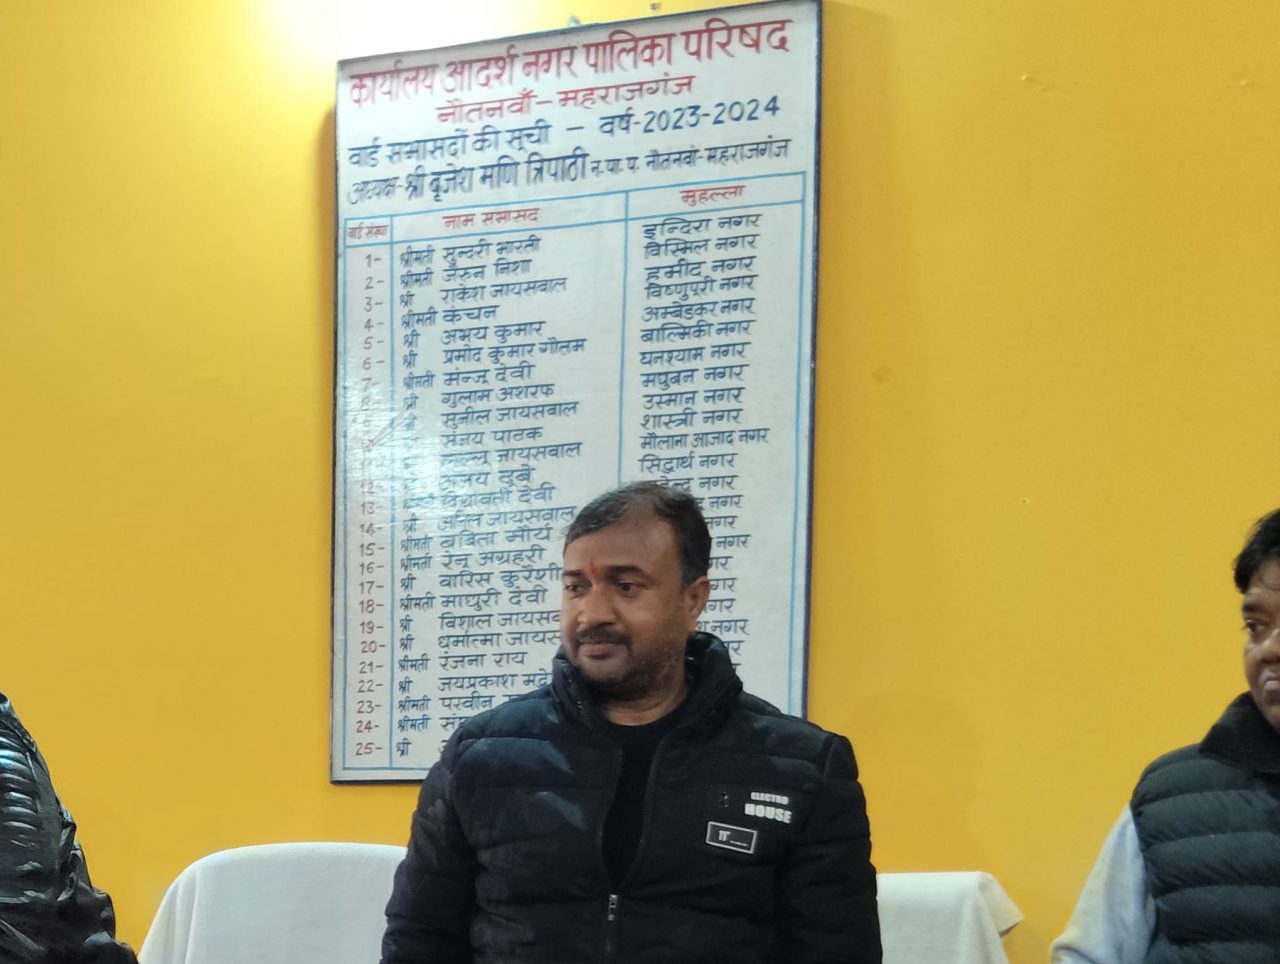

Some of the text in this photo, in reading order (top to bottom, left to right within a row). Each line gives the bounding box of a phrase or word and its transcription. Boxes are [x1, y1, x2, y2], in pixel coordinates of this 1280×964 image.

[350, 17, 794, 106] कार्यालय आदर्श नगर पालिका परिषद
[557, 72, 696, 109] महराजगंज
[348, 136, 382, 167] वार्ड
[386, 128, 469, 164] सभासदों
[472, 124, 502, 151] की
[505, 118, 552, 153] सूची
[429, 163, 475, 202] बृजेश
[480, 155, 520, 190] मणि
[524, 146, 589, 186] त्रिपाठी
[680, 185, 746, 206] मुहल्ला
[442, 208, 540, 229] नाम सभासद
[642, 214, 763, 241] इन्दिरा नगर
[496, 234, 542, 255] भारती
[715, 234, 761, 252] नगर
[493, 257, 533, 277] निशा
[644, 256, 757, 282] हमीद नगर
[400, 277, 568, 308] श्री राकेश जायसवाल
[719, 274, 759, 291] नगर
[401, 305, 500, 330] श्रीमती कंचन
[641, 297, 756, 323] अम्बेडकर नगर
[403, 321, 547, 349] श्री अभय कुमार
[715, 319, 757, 337] नगर
[403, 337, 587, 369] श्री प्रमोद कुमार गौतम
[639, 341, 752, 367] घनश्याम नगर
[403, 370, 436, 391] श्रीमती
[494, 360, 536, 382] देवी
[703, 364, 750, 382] नगर
[403, 383, 555, 411] श्री गुलाम अशरफ
[642, 387, 746, 410] उस्मान नगर
[440, 406, 492, 429] सुनील
[496, 401, 579, 422] जायसवाल
[640, 407, 744, 430] शास्त्री नगर
[491, 426, 543, 443] पाठक
[640, 428, 771, 450] मौलाना आजाद नगर
[496, 442, 583, 462] जायसवाल
[637, 450, 738, 474] सिद्धार्थ नगर
[518, 481, 556, 503] देवी
[698, 475, 739, 490] नगर
[707, 494, 744, 509] नगर
[403, 512, 421, 534] श्री
[487, 505, 577, 526] जायसवाल
[400, 534, 433, 552] श्रीमती
[715, 534, 751, 550] नगर
[400, 552, 433, 572] श्रीमती
[478, 544, 546, 566] अग्रहरी
[400, 573, 416, 592] श्री
[438, 569, 494, 588] वारिस
[708, 578, 737, 593] गर
[400, 584, 548, 612] श्रीमती माधुरी देवी
[400, 614, 413, 632] श्री
[438, 612, 494, 630] विशाल
[711, 619, 749, 636] नगर
[400, 634, 415, 652] श्री
[438, 629, 502, 649] धर्मात्मा
[398, 651, 528, 672] श्रीमती रंजना राय
[399, 676, 414, 694] श्री
[438, 674, 518, 691] जयप्रकाश
[398, 695, 432, 713] श्रीमती
[439, 690, 495, 710] परवीन
[398, 714, 432, 732] श्रीमती
[396, 737, 412, 756] श्री
